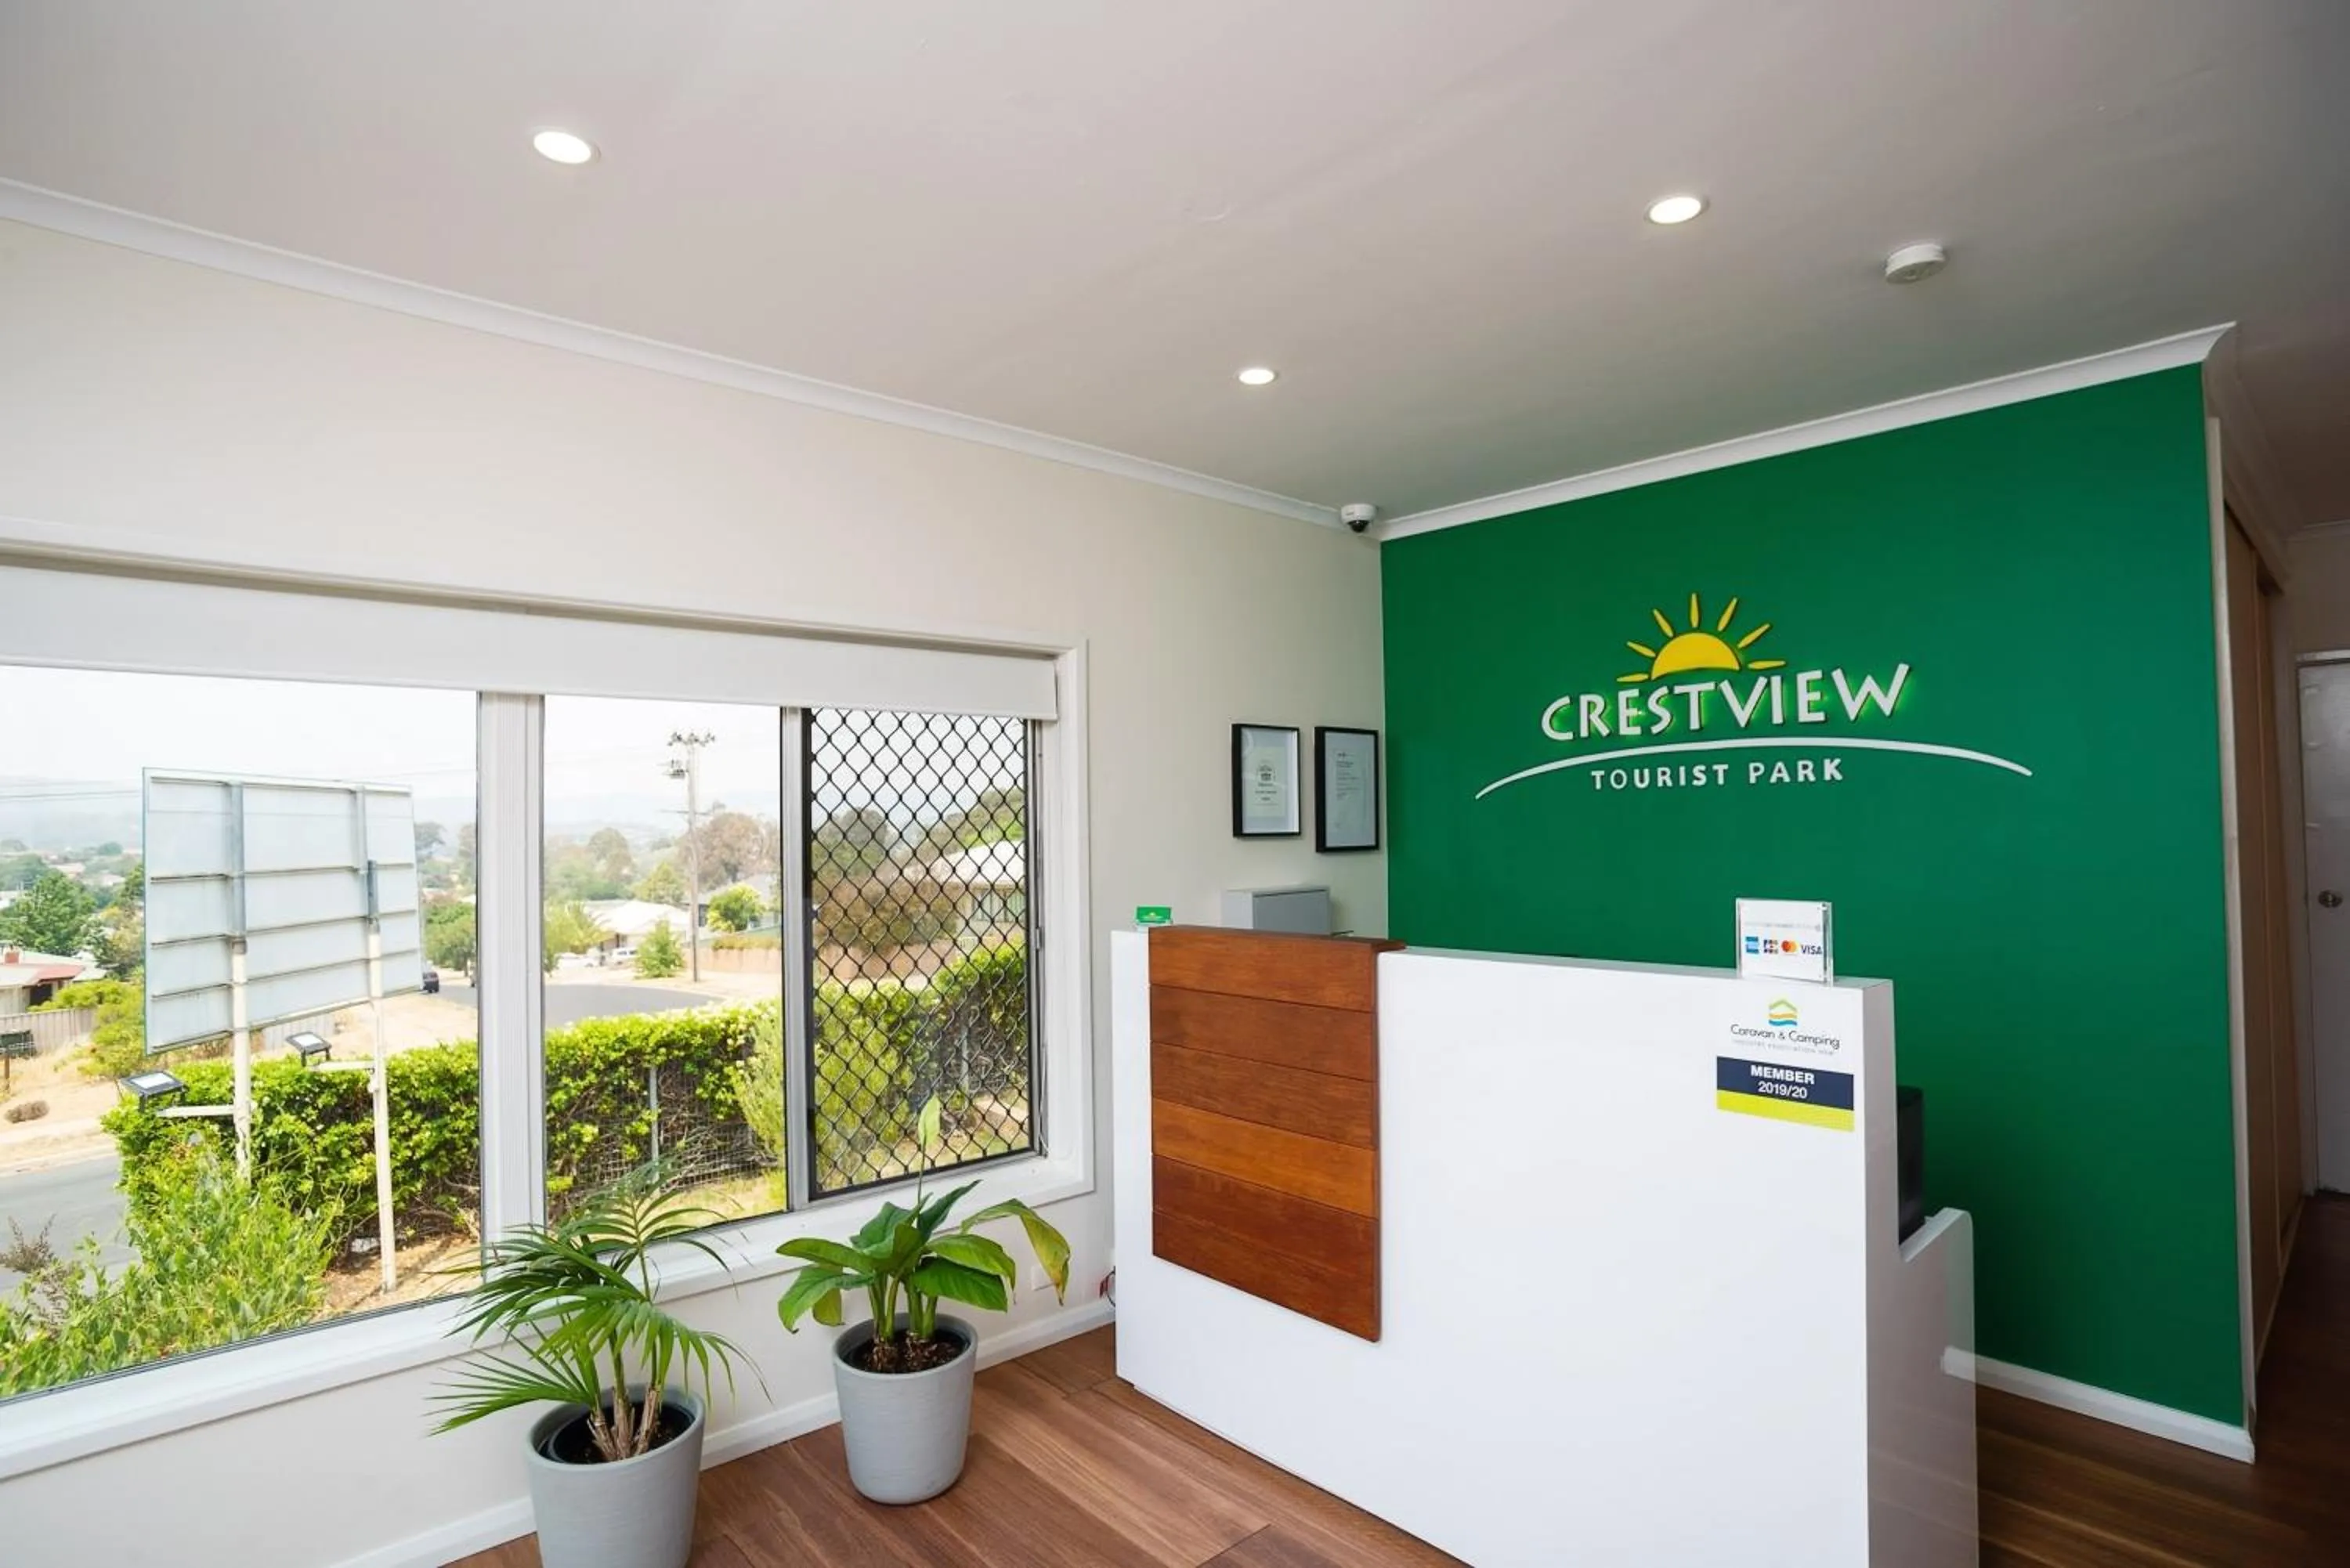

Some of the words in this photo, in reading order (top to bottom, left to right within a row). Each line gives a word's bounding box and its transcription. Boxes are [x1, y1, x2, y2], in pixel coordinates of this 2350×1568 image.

[1541, 663, 1911, 741] CRESTVIEW
[1591, 764, 1729, 789] TOURIST
[1748, 757, 1843, 784] PARK
[1801, 945, 1822, 955] VISA
[1730, 1024, 1775, 1039] Caravan
[1788, 1030, 1840, 1050] Camping
[1751, 1064, 1815, 1085] MEMBER
[1758, 1080, 1808, 1099] 2019/20
